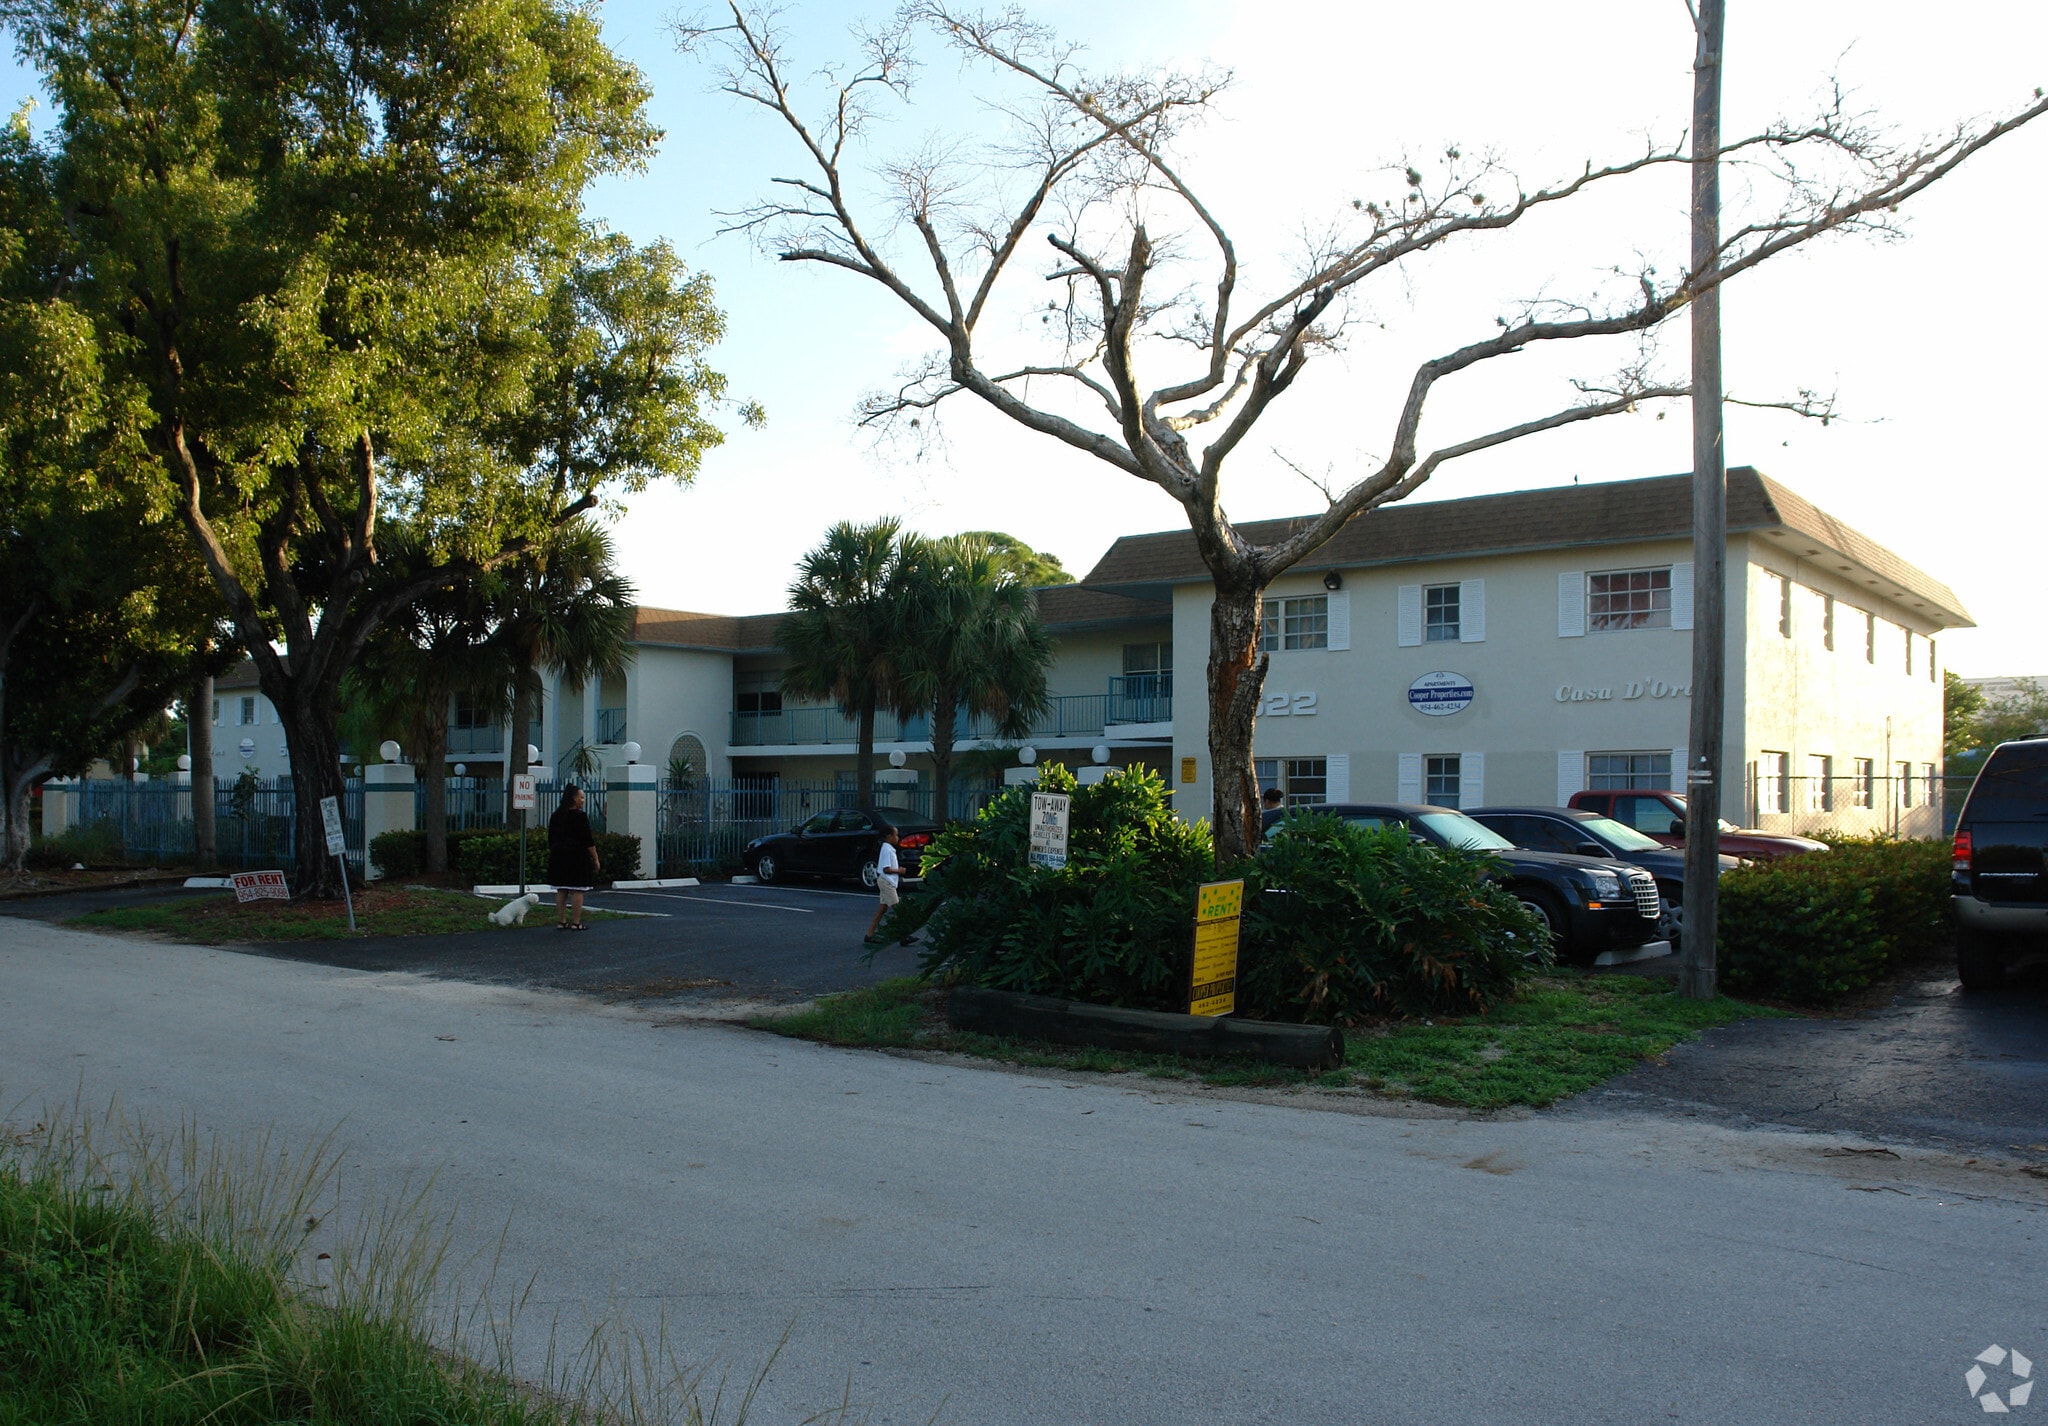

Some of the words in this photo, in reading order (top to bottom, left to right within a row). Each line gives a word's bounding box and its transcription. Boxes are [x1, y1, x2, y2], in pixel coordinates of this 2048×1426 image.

[1410, 691, 1430, 701] Cooper
[1431, 689, 1473, 700] Properties.com
[1555, 684, 1614, 703] Casa
[1420, 702, 1461, 710] 954-462-4234
[520, 781, 530, 789] NO
[1034, 796, 1066, 812] TOW-AWAY
[1042, 811, 1057, 825] ZONE
[1035, 824, 1063, 833] UNAUTHORIZED
[1033, 831, 1051, 840] VEHICLES
[1051, 833, 1064, 841] TOWED
[1032, 845, 1047, 853] OWNER'S
[1048, 847, 1064, 855] EXPENSE
[234, 876, 256, 888] FOR
[257, 874, 283, 885] RENT
[1208, 902, 1233, 917] RENT
